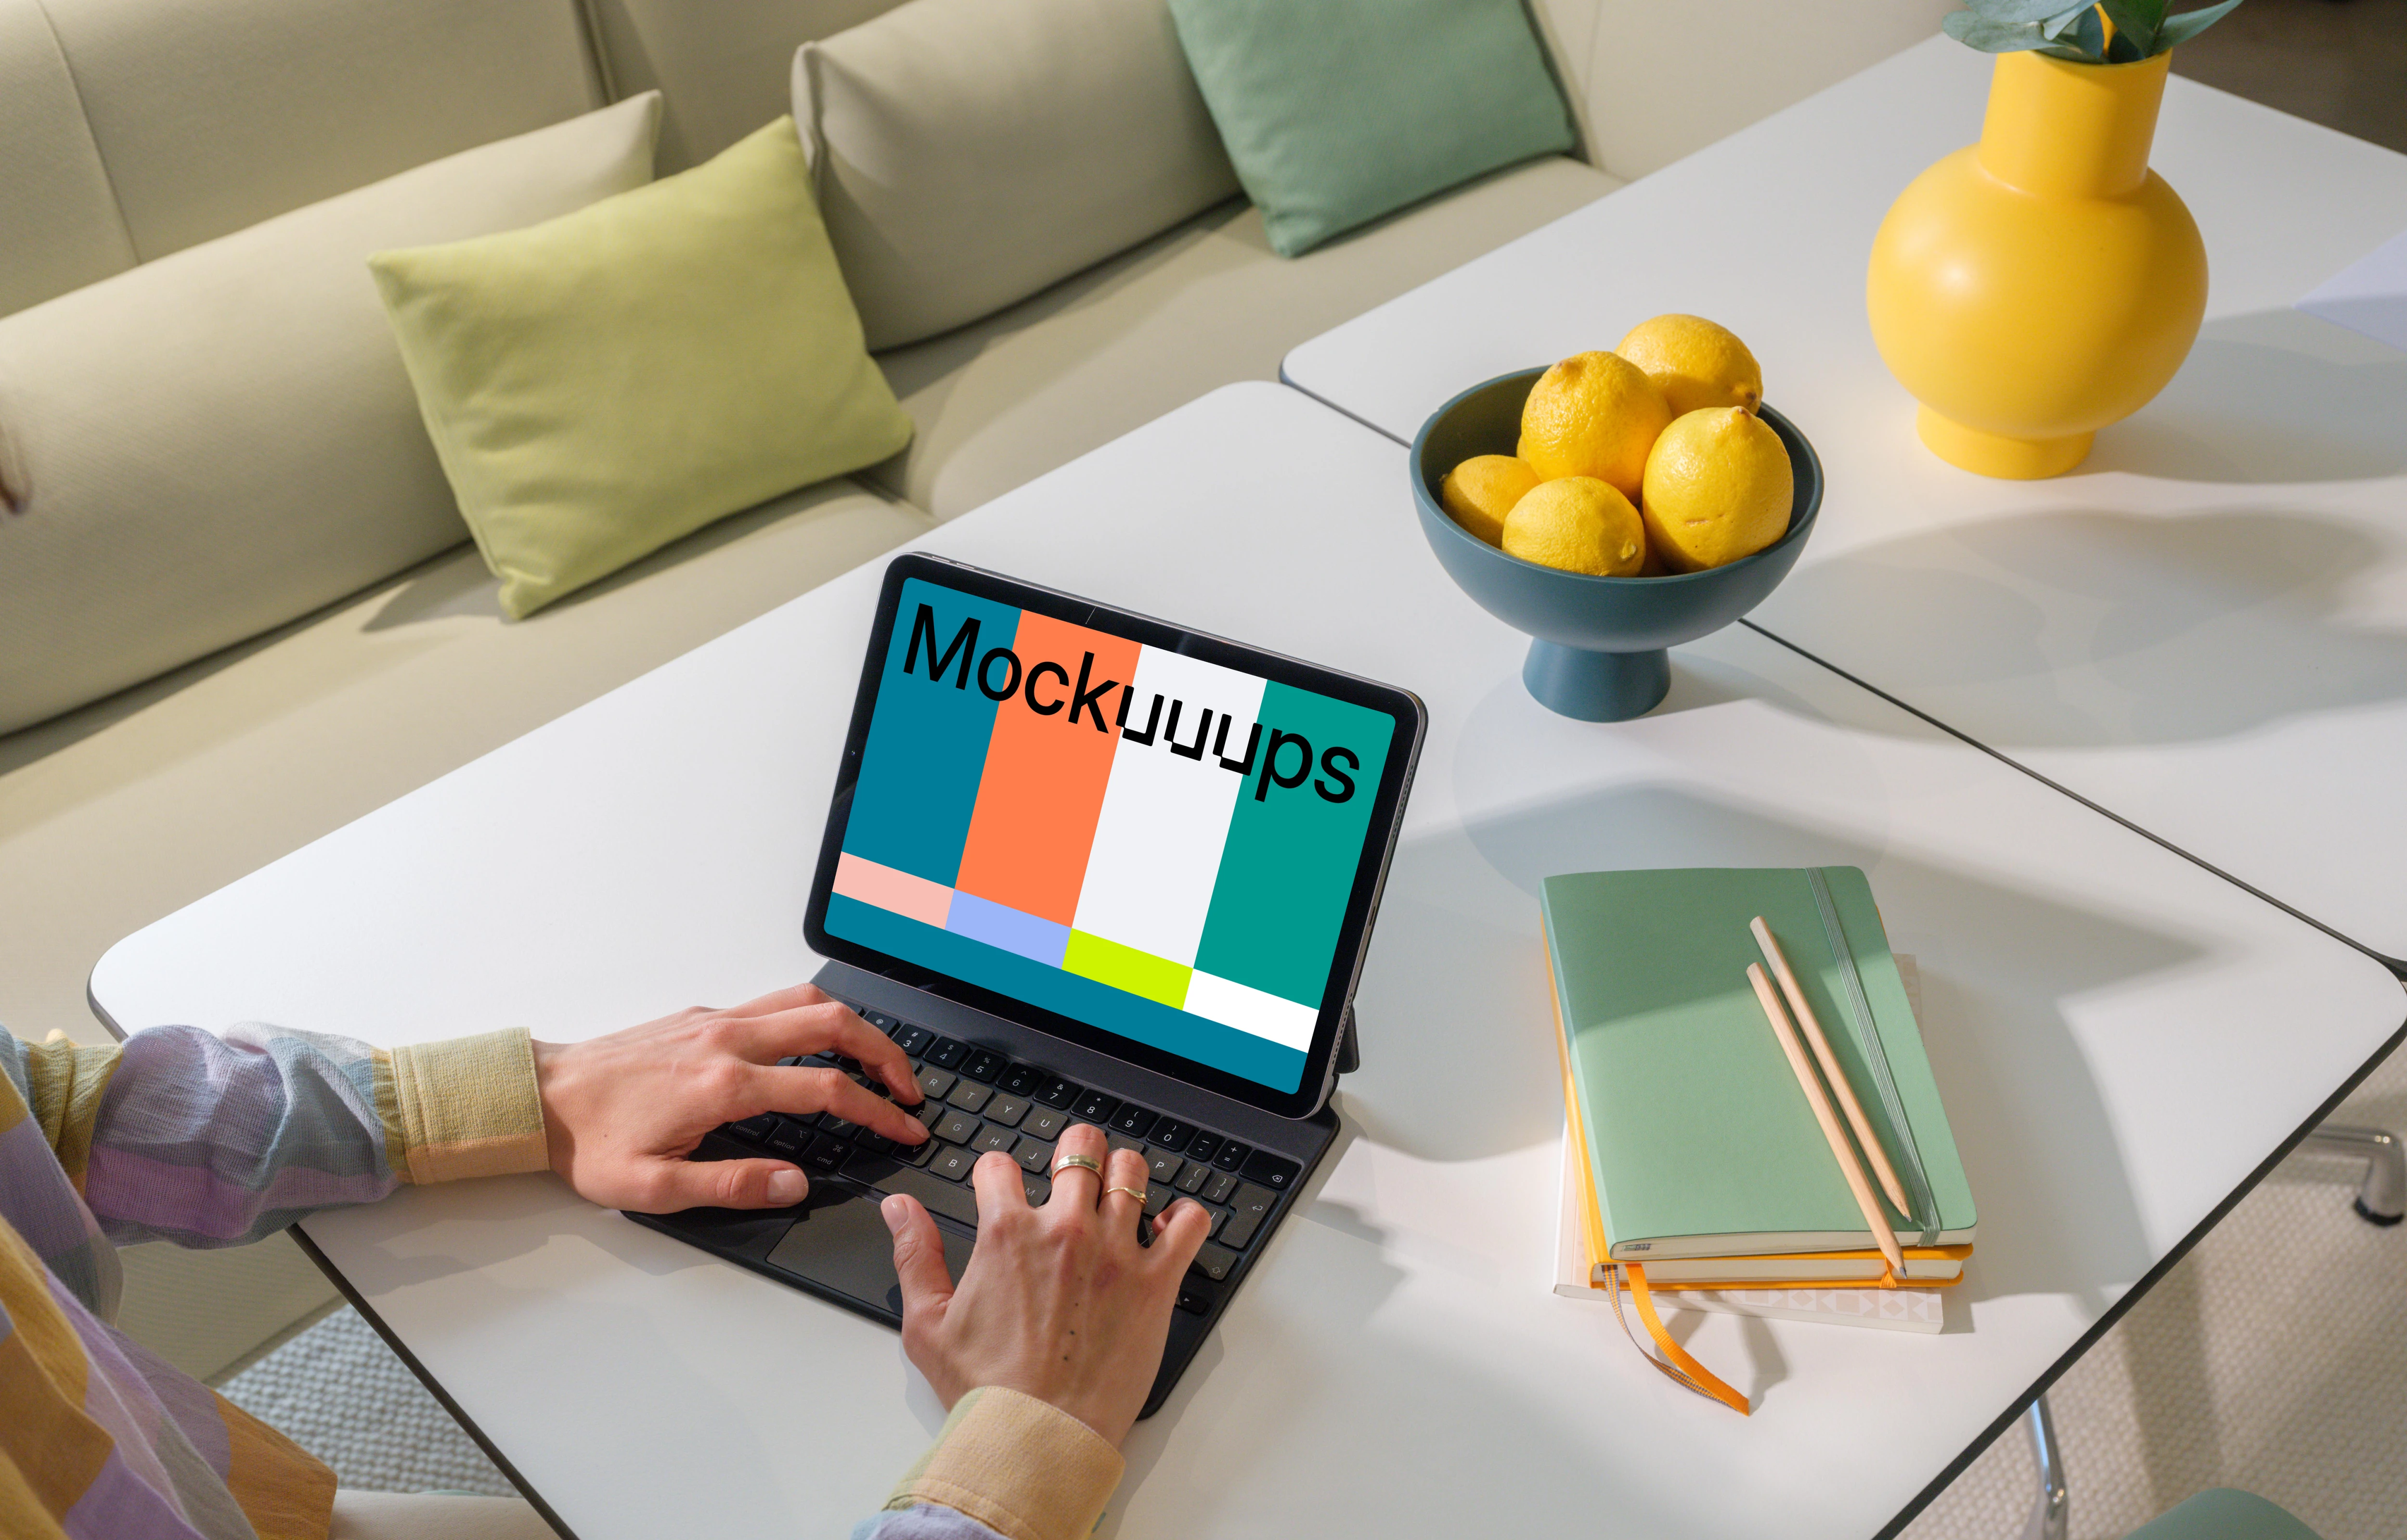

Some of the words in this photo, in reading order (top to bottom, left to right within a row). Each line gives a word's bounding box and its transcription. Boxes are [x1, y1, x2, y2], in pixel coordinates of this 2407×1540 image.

[903, 603, 1360, 804] Mockuuups
[1040, 1119, 1050, 1127] U
[736, 1124, 760, 1137] control
[773, 1139, 795, 1151] option
[989, 1137, 1000, 1146] H
[816, 1155, 833, 1165] cmd
[948, 1159, 958, 1167] B
[1025, 1187, 1035, 1196] M
